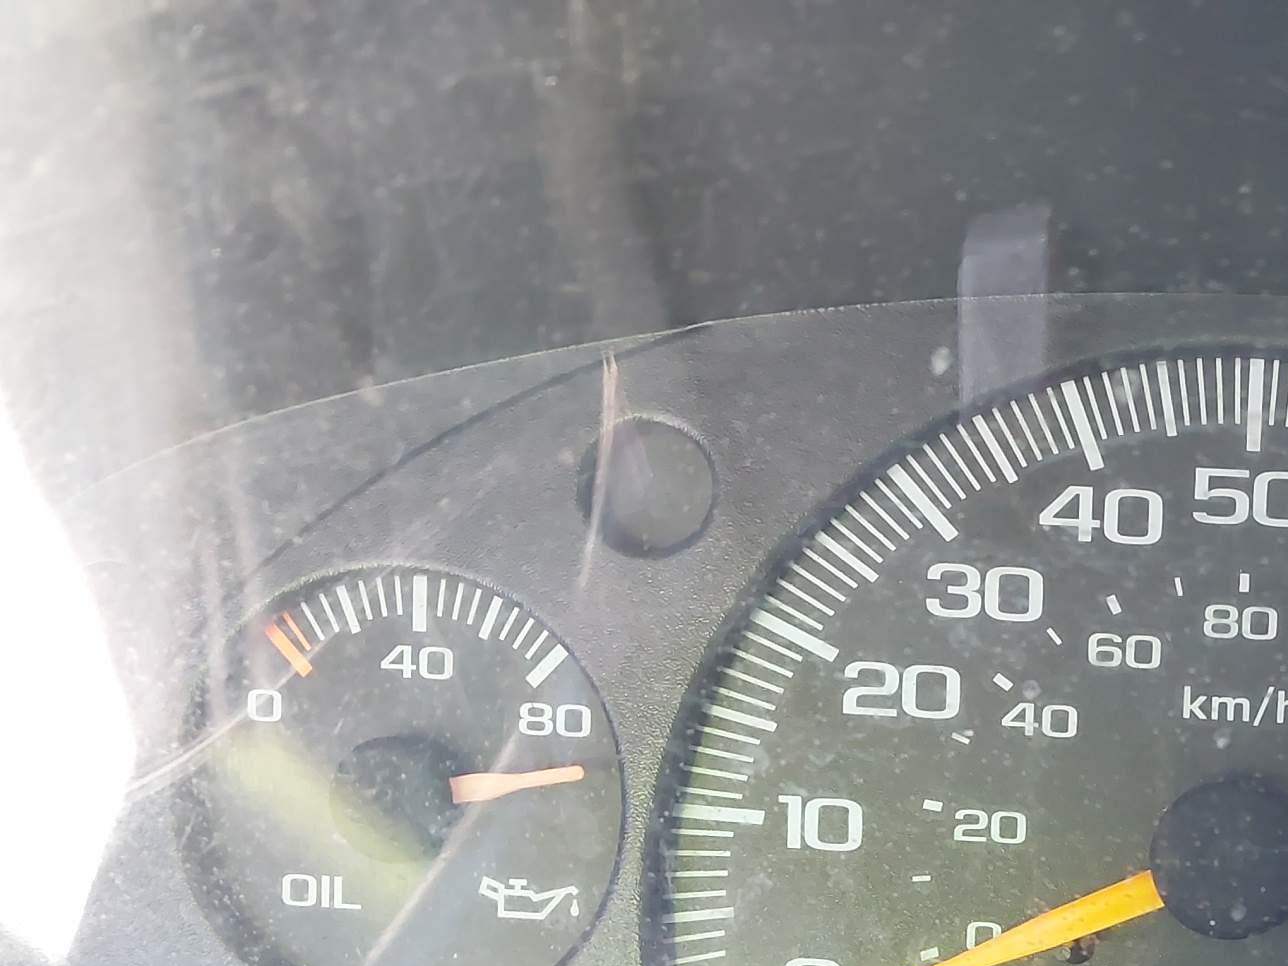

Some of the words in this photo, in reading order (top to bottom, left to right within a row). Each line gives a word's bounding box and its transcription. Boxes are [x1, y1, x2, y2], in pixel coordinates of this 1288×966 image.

[1039, 485, 1164, 545] 40
[925, 562, 1045, 622] 30
[1203, 604, 1278, 640] 80
[380, 645, 454, 680] 40
[1087, 633, 1162, 670] 60
[247, 688, 283, 722] 0
[842, 661, 961, 719] 20
[518, 702, 592, 738] 80
[1001, 703, 1078, 739] 40
[778, 795, 863, 852] 10
[953, 809, 1027, 845] 20
[281, 873, 362, 910] OIL
